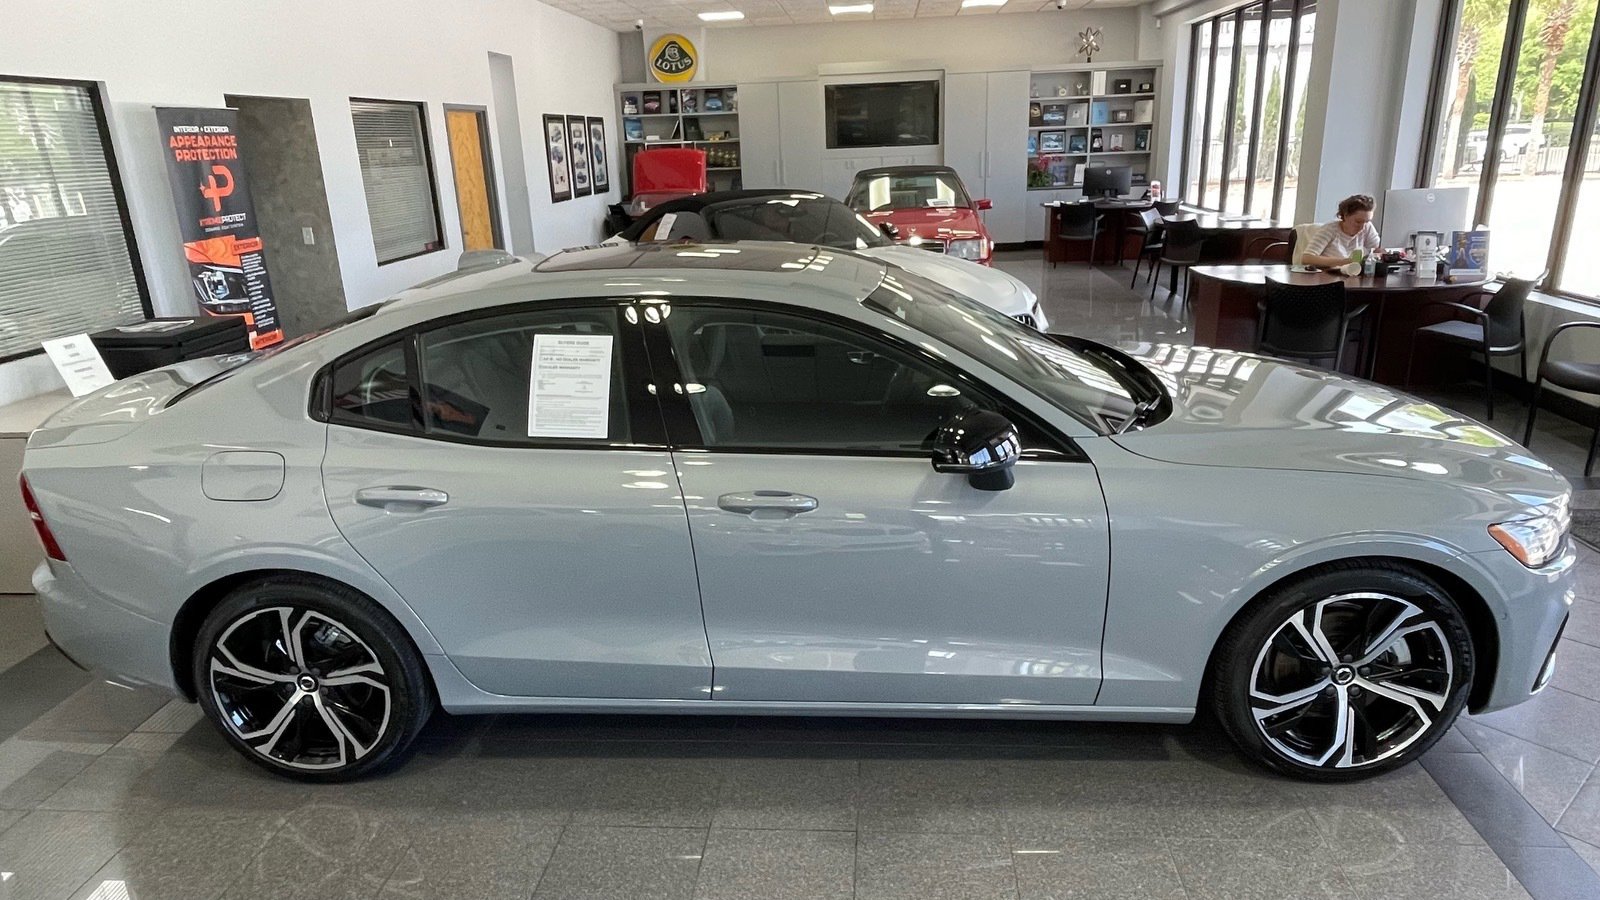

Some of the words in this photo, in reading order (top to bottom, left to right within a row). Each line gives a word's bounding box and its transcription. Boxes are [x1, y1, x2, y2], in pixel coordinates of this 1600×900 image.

[656, 57, 692, 70] LOTUS
[173, 125, 200, 133] INTERIOR
[203, 125, 229, 133] EXTERIOR
[170, 135, 237, 148] APPEARANCE
[175, 148, 238, 162] PROTECTION
